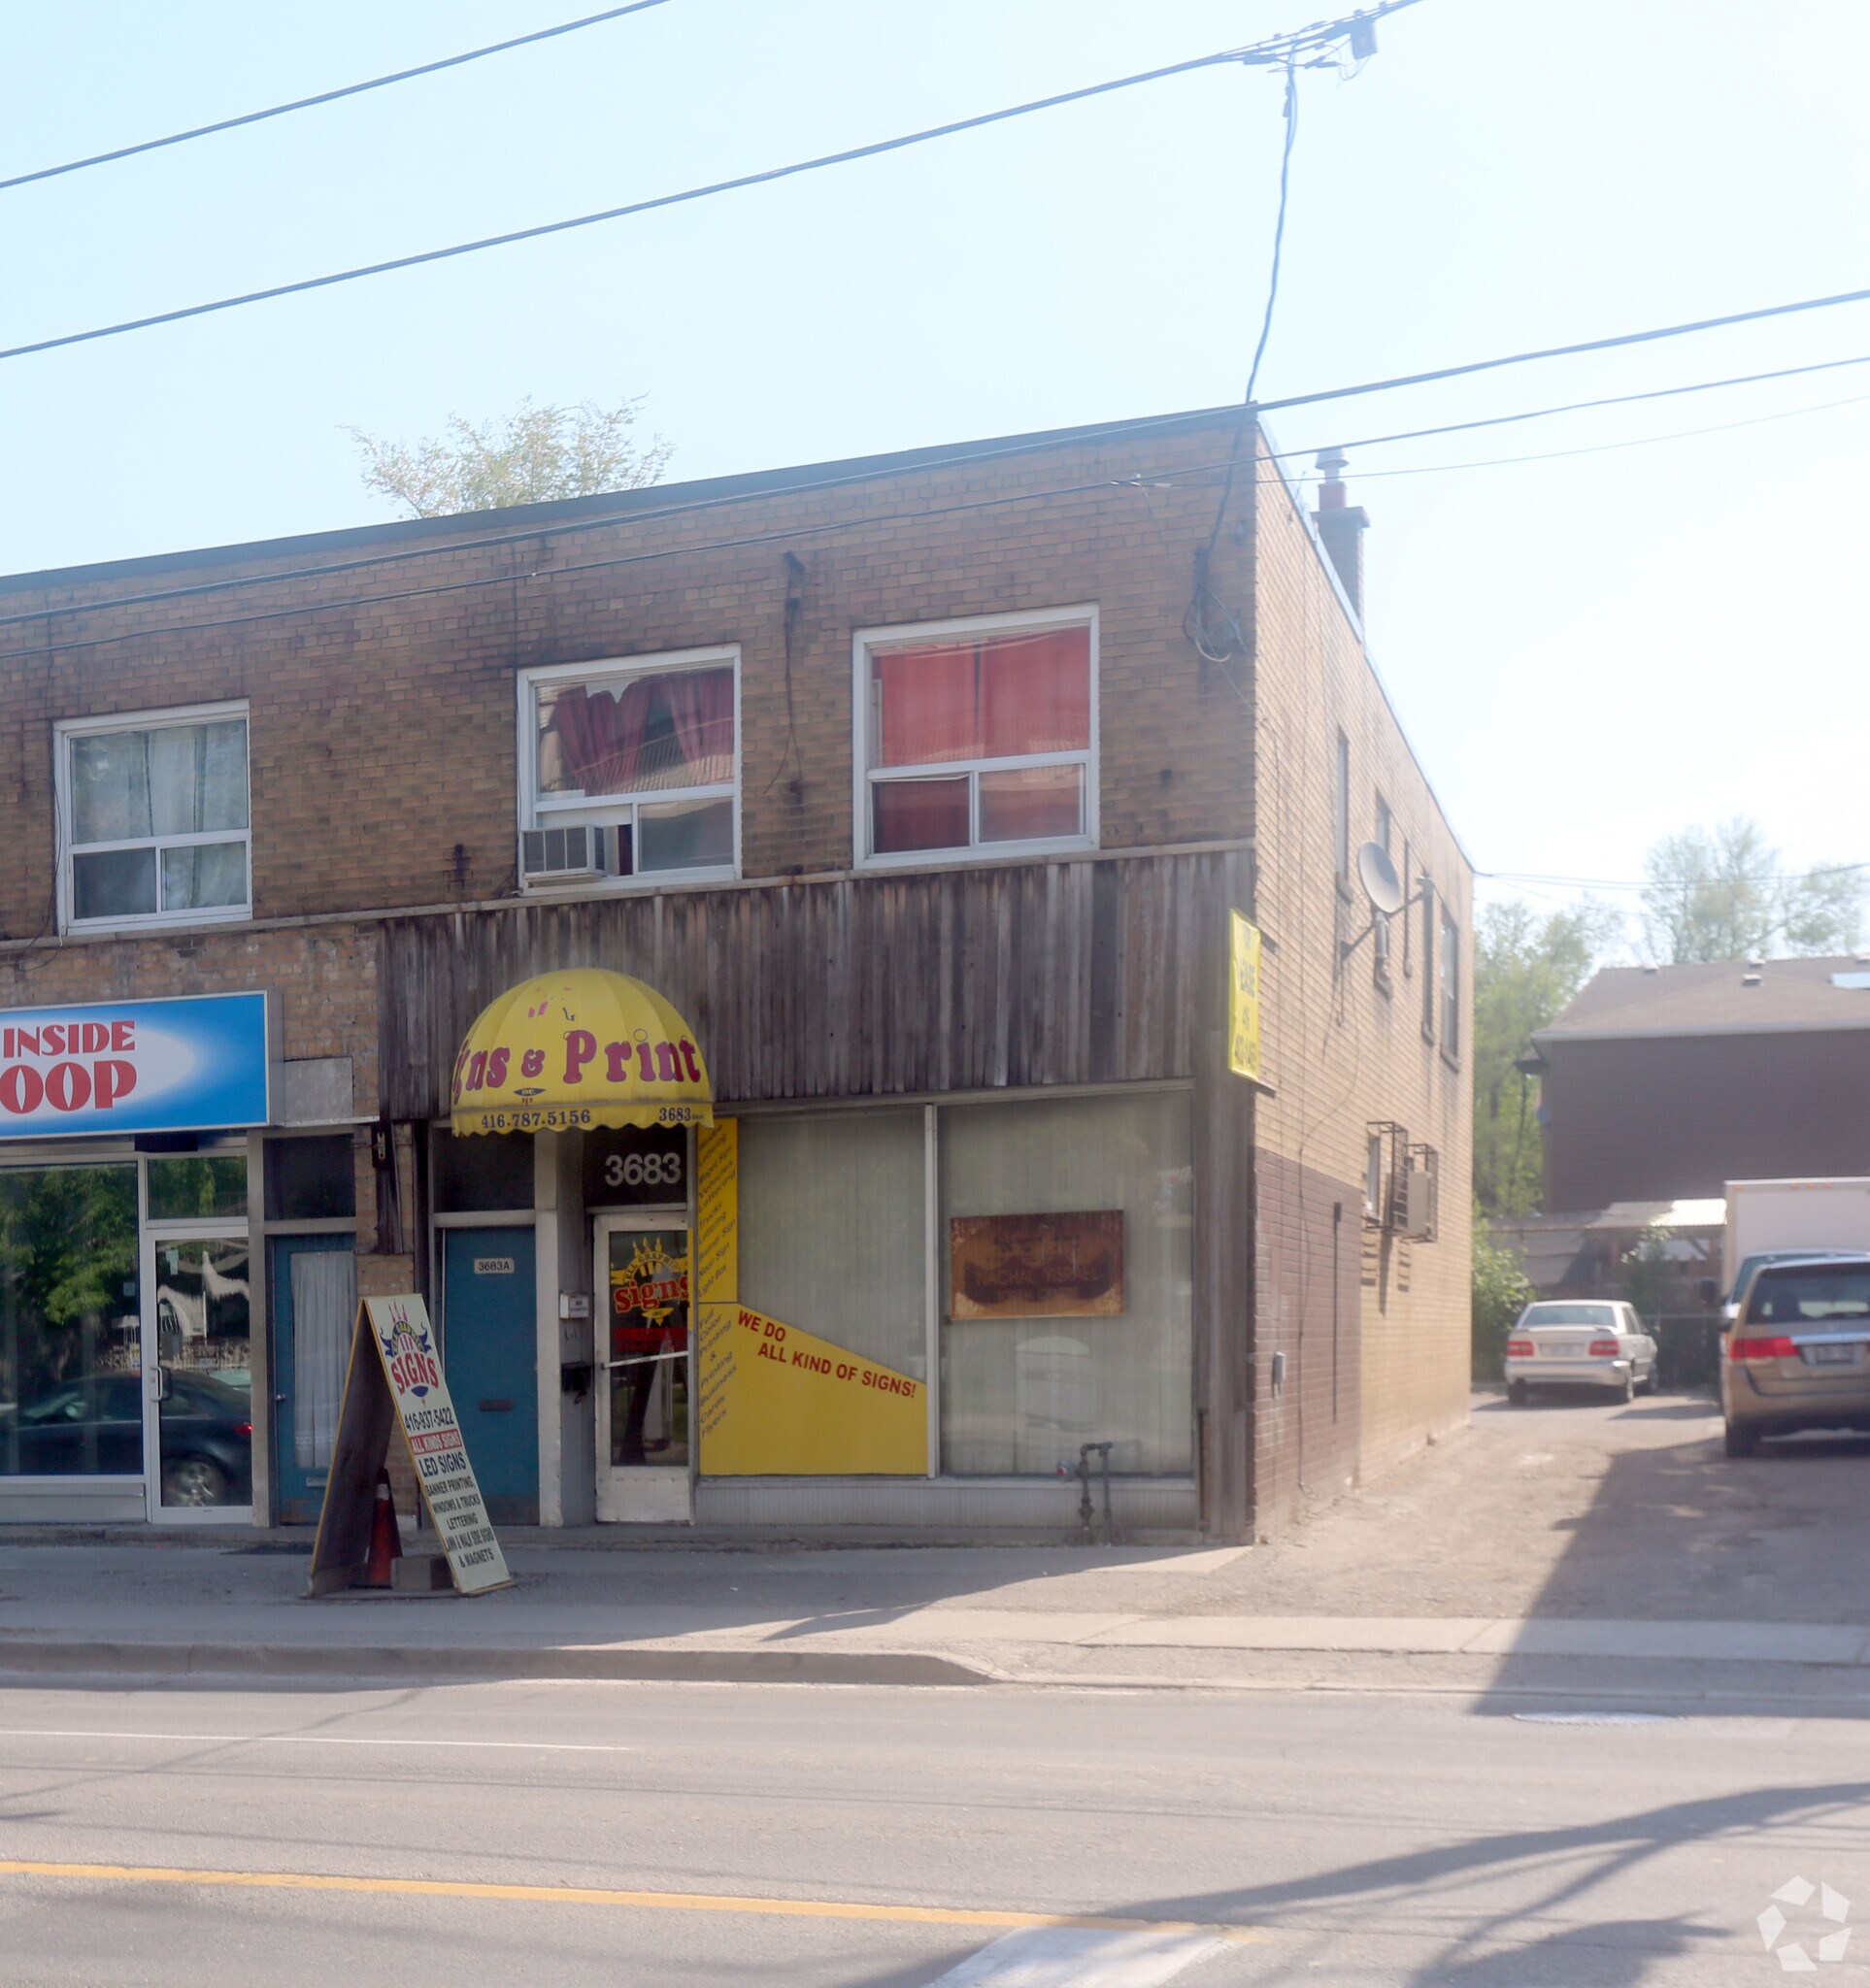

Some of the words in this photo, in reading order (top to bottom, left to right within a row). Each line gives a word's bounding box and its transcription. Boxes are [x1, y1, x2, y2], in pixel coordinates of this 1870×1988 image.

[3, 1020, 136, 1058] INSIDE
[520, 1048, 546, 1078] &
[562, 1029, 701, 1084] Print
[481, 1110, 591, 1129] 416.787.5156
[658, 1107, 691, 1122] 3683
[604, 1151, 681, 1187] 3683
[477, 1260, 511, 1272] 3683A
[738, 1309, 761, 1333] WE
[763, 1323, 786, 1342] DO
[390, 1351, 440, 1396] SIGNS
[757, 1342, 787, 1364] ALL
[791, 1351, 831, 1375] KIND
[836, 1363, 858, 1381] OF
[861, 1370, 917, 1399] SIGNS!
[417, 1457, 439, 1478] LED
[437, 1451, 467, 1474] SIGNS
